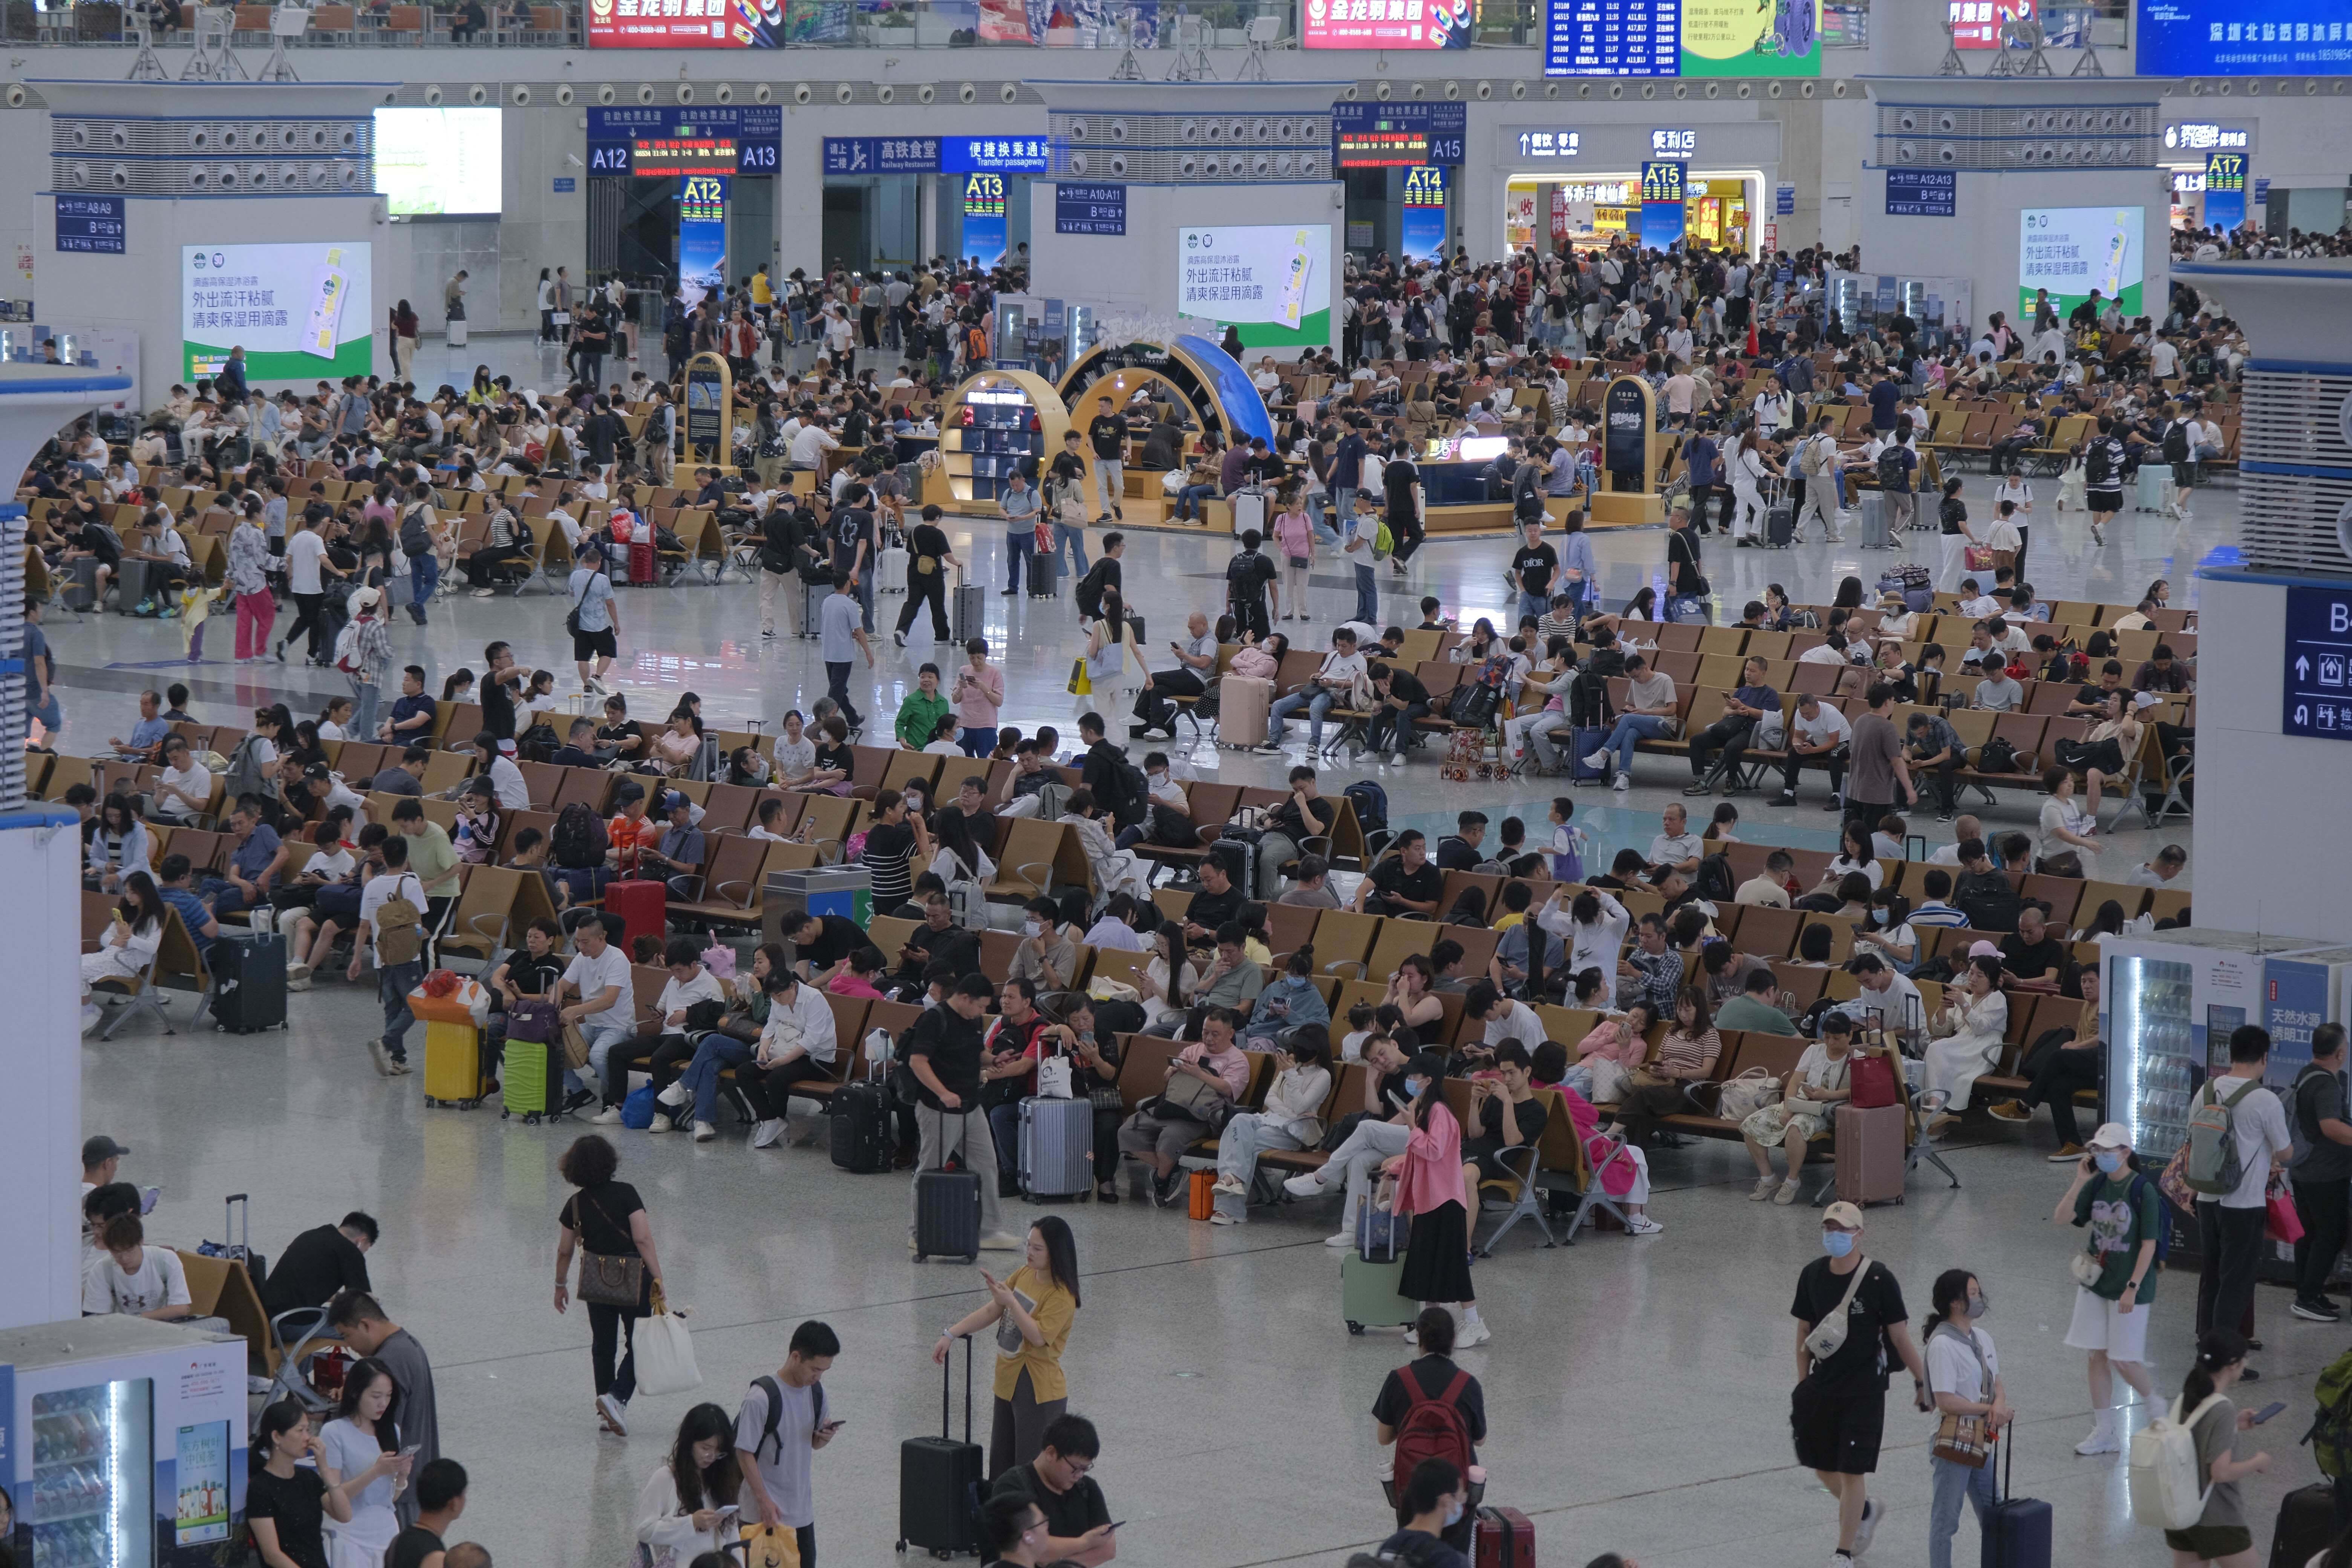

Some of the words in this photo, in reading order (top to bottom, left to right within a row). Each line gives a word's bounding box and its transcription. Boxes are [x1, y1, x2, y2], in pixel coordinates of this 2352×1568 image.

[1330, 1, 1423, 20] 金龙羽集团
[604, 111, 662, 121] 自助检票通道
[680, 110, 737, 121] 自助检票通道
[1379, 105, 1428, 116] 自助检票通道
[1652, 130, 1695, 149] 便利店
[829, 143, 847, 155] 请上
[881, 141, 937, 159] 高铁食堂
[1433, 140, 1461, 158] A15
[591, 149, 626, 168] A12
[743, 147, 775, 166] A13
[830, 157, 847, 169] 二楼
[881, 161, 904, 170] Railway
[977, 157, 1004, 166] Transfer
[1005, 159, 1045, 168] passageway
[2209, 158, 2242, 173] A17
[1407, 171, 1442, 187] A14
[1645, 167, 1679, 184] A15
[684, 182, 721, 200] A12
[966, 177, 1003, 195] A13
[1921, 190, 1928, 200] B
[1091, 206, 1097, 217] B
[90, 222, 96, 233] B
[1187, 254, 1240, 265] 滴露高保湿沐浴露
[2026, 245, 2080, 260] 外出流汗粘腻
[1187, 267, 1253, 284] 外出流汗粘腻
[2026, 261, 2088, 276] 清爽保湿用滴露
[193, 276, 259, 287] 滴露高保湿沐浴露
[193, 289, 275, 308] 外出流汗粘腻
[1187, 285, 1263, 302] 清爽保湿用滴露
[193, 310, 288, 329] 清爽保湿用滴露
[1524, 558, 1544, 567] DIOR
[2331, 603, 2352, 632] B
[2272, 1008, 2321, 1028] 天然水源
